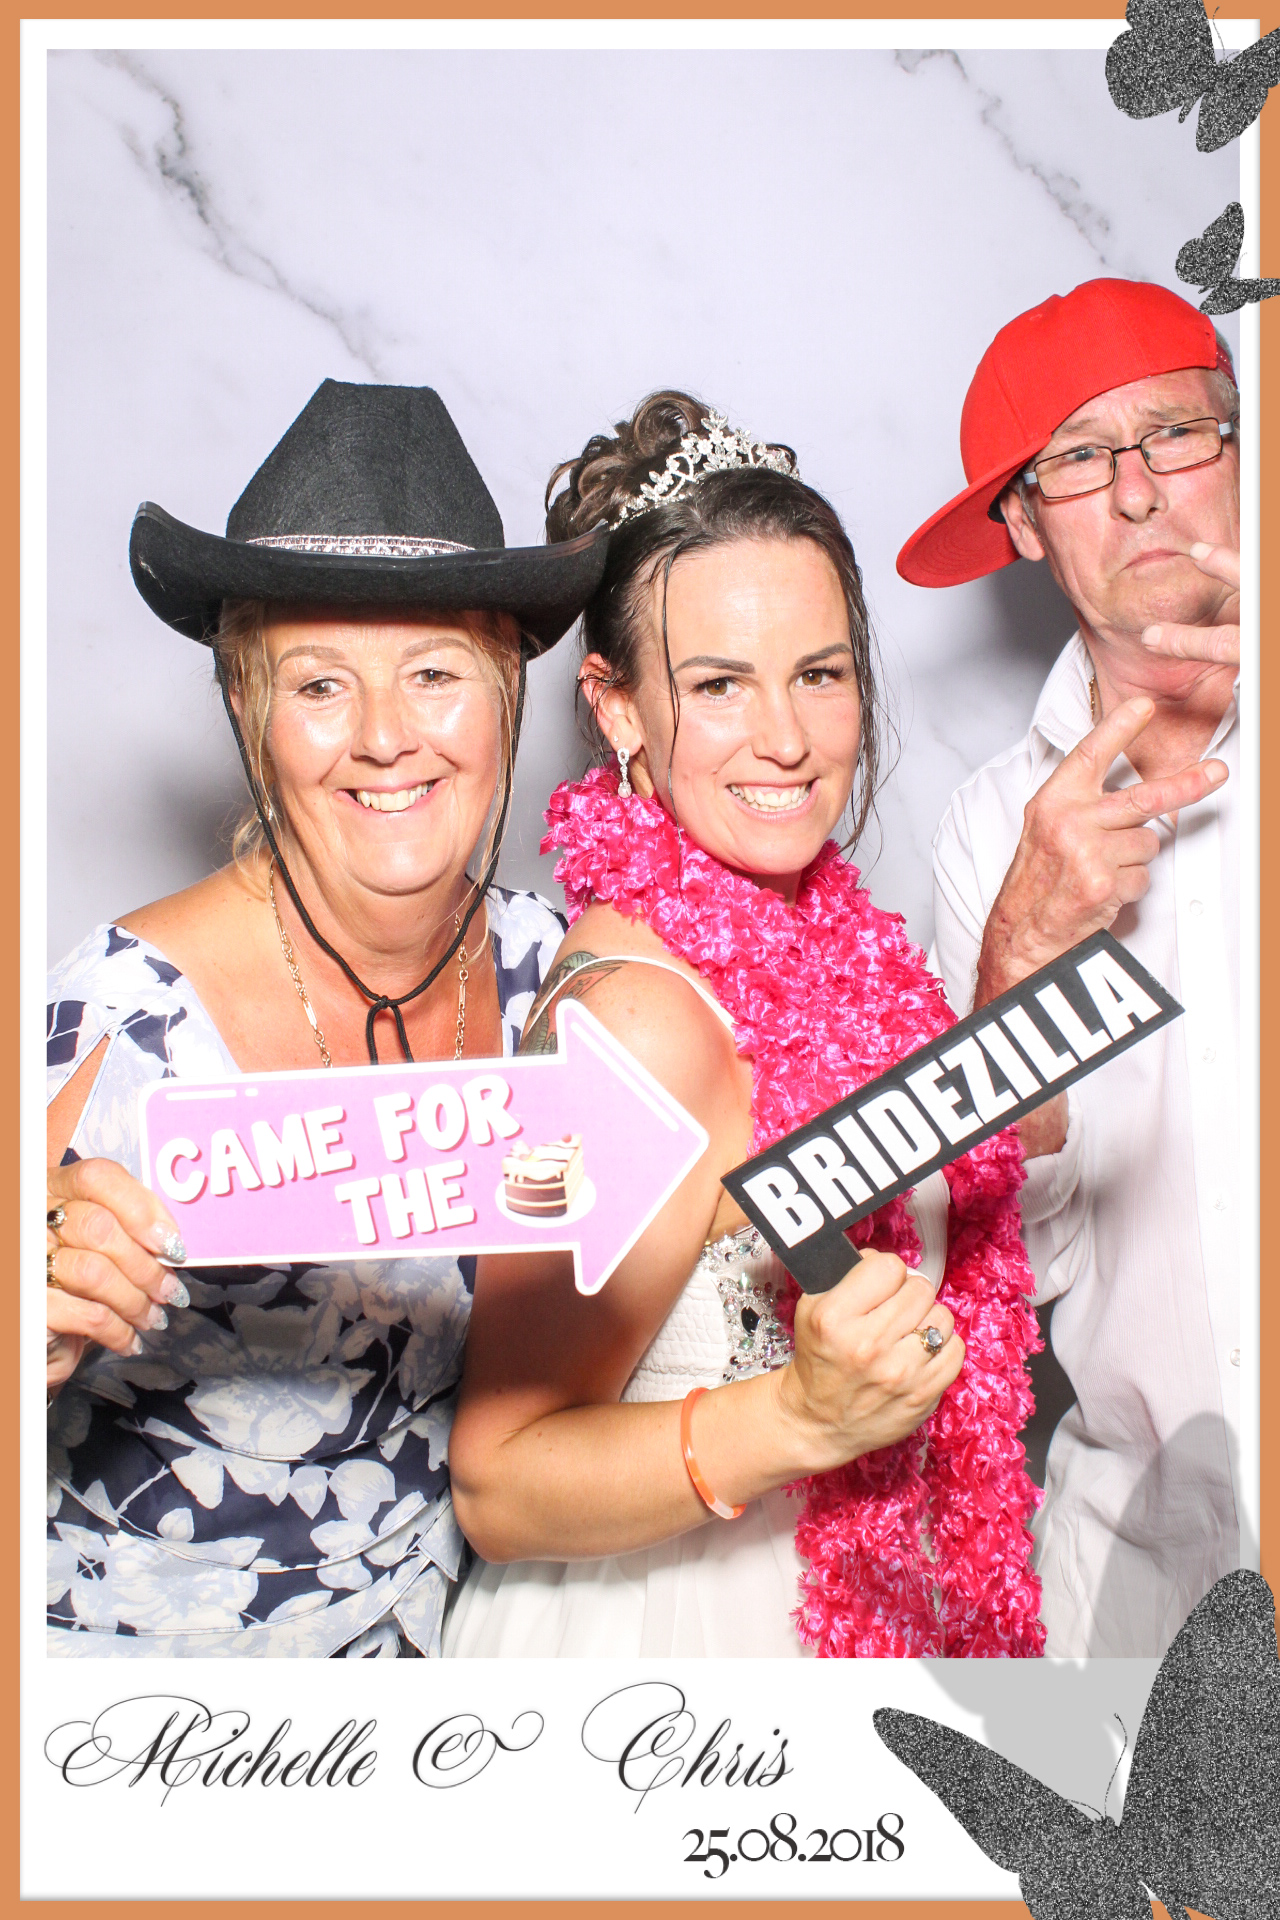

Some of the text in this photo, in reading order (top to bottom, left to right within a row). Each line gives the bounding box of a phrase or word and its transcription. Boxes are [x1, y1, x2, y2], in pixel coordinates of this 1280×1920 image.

[156, 1074, 522, 1204] CAME FOR
[742, 949, 1163, 1249] BRIDEZILLA
[334, 1160, 477, 1245] THE
